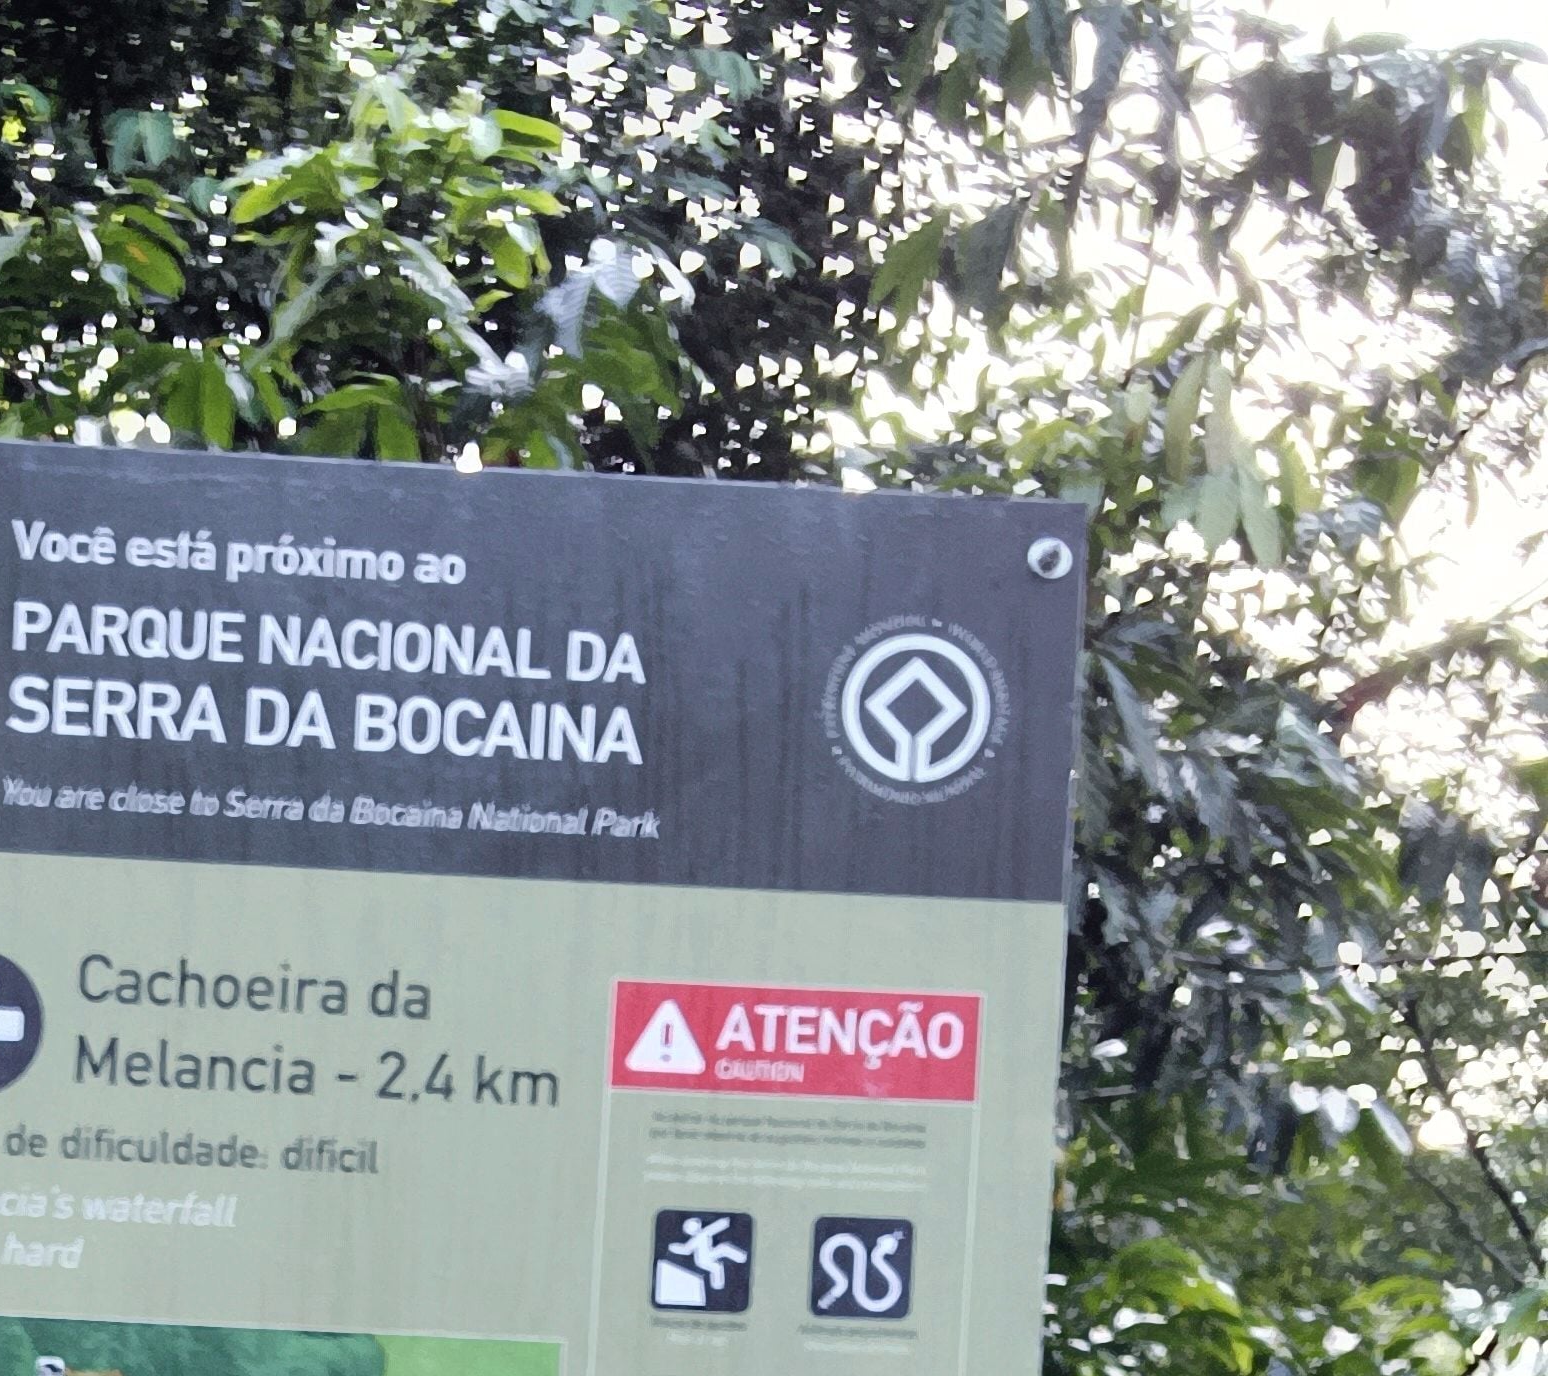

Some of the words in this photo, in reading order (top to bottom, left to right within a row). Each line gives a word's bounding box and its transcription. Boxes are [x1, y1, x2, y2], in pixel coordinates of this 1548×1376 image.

[11, 519, 117, 565] Você
[125, 528, 216, 571] está
[226, 533, 404, 582] próximo
[414, 552, 466, 585] ao
[11, 600, 246, 663] PARQUE
[258, 613, 551, 680] NACIONAL
[566, 629, 646, 685] DA
[5, 675, 226, 744] SERRA
[243, 687, 336, 750] DA
[353, 693, 643, 765] BOCAINA
[2, 774, 52, 807] You
[54, 785, 105, 810] are
[108, 780, 185, 814] close
[189, 785, 219, 816] to
[223, 784, 304, 821] Serra
[308, 788, 345, 823] da
[349, 793, 463, 830] Bocaina
[467, 798, 586, 835] National
[591, 807, 661, 839] Park
[78, 954, 348, 1017] Cachoeira
[371, 968, 432, 1020] da
[715, 1000, 965, 1070] ATENÇÃO
[74, 1035, 315, 1096] Melancia
[474, 1055, 559, 1107] km
[5, 1121, 49, 1158] de
[60, 1126, 268, 1171] dificuldade:
[80, 1190, 239, 1228] waterfall
[3, 1231, 84, 1269] hard
